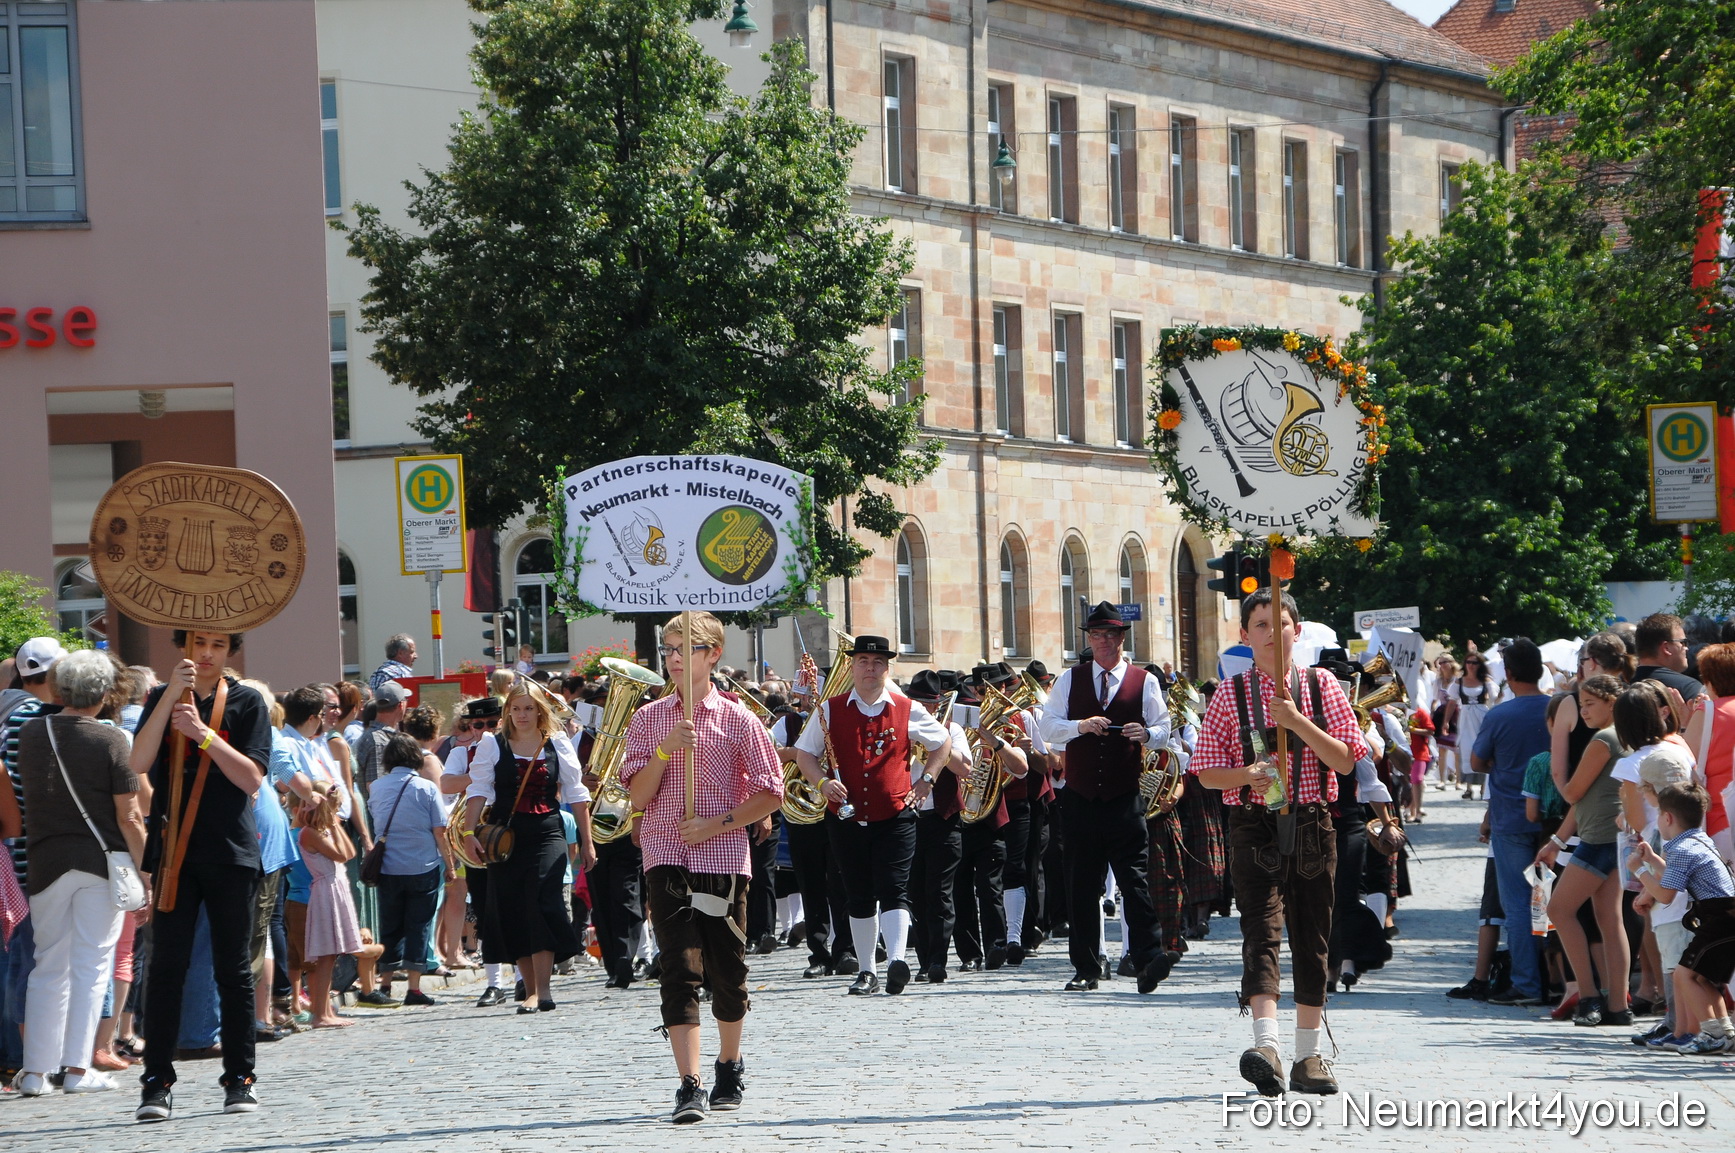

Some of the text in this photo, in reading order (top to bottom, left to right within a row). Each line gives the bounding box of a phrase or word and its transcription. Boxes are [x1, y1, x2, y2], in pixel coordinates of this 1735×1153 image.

[565, 456, 797, 501] Partnerschaftskapelle
[1658, 466, 1711, 476] Oberer Markt
[138, 475, 267, 522] STADTKAPELLE
[579, 482, 669, 523] Neumarkt
[686, 481, 783, 520] Mistelbach
[1182, 466, 1304, 528] BLASKAPELLE
[1305, 456, 1366, 519] PÖLLING
[406, 517, 457, 527] Oberer Markt
[745, 526, 763, 551] STADT-
[742, 536, 774, 581] MISTELBACH
[745, 531, 769, 563] KAPELLE
[605, 561, 656, 588] BLASKAPELLE
[656, 558, 683, 584] PÖLLING
[125, 575, 261, 619] MISTELBACH
[603, 582, 772, 606] Musik verbindet
